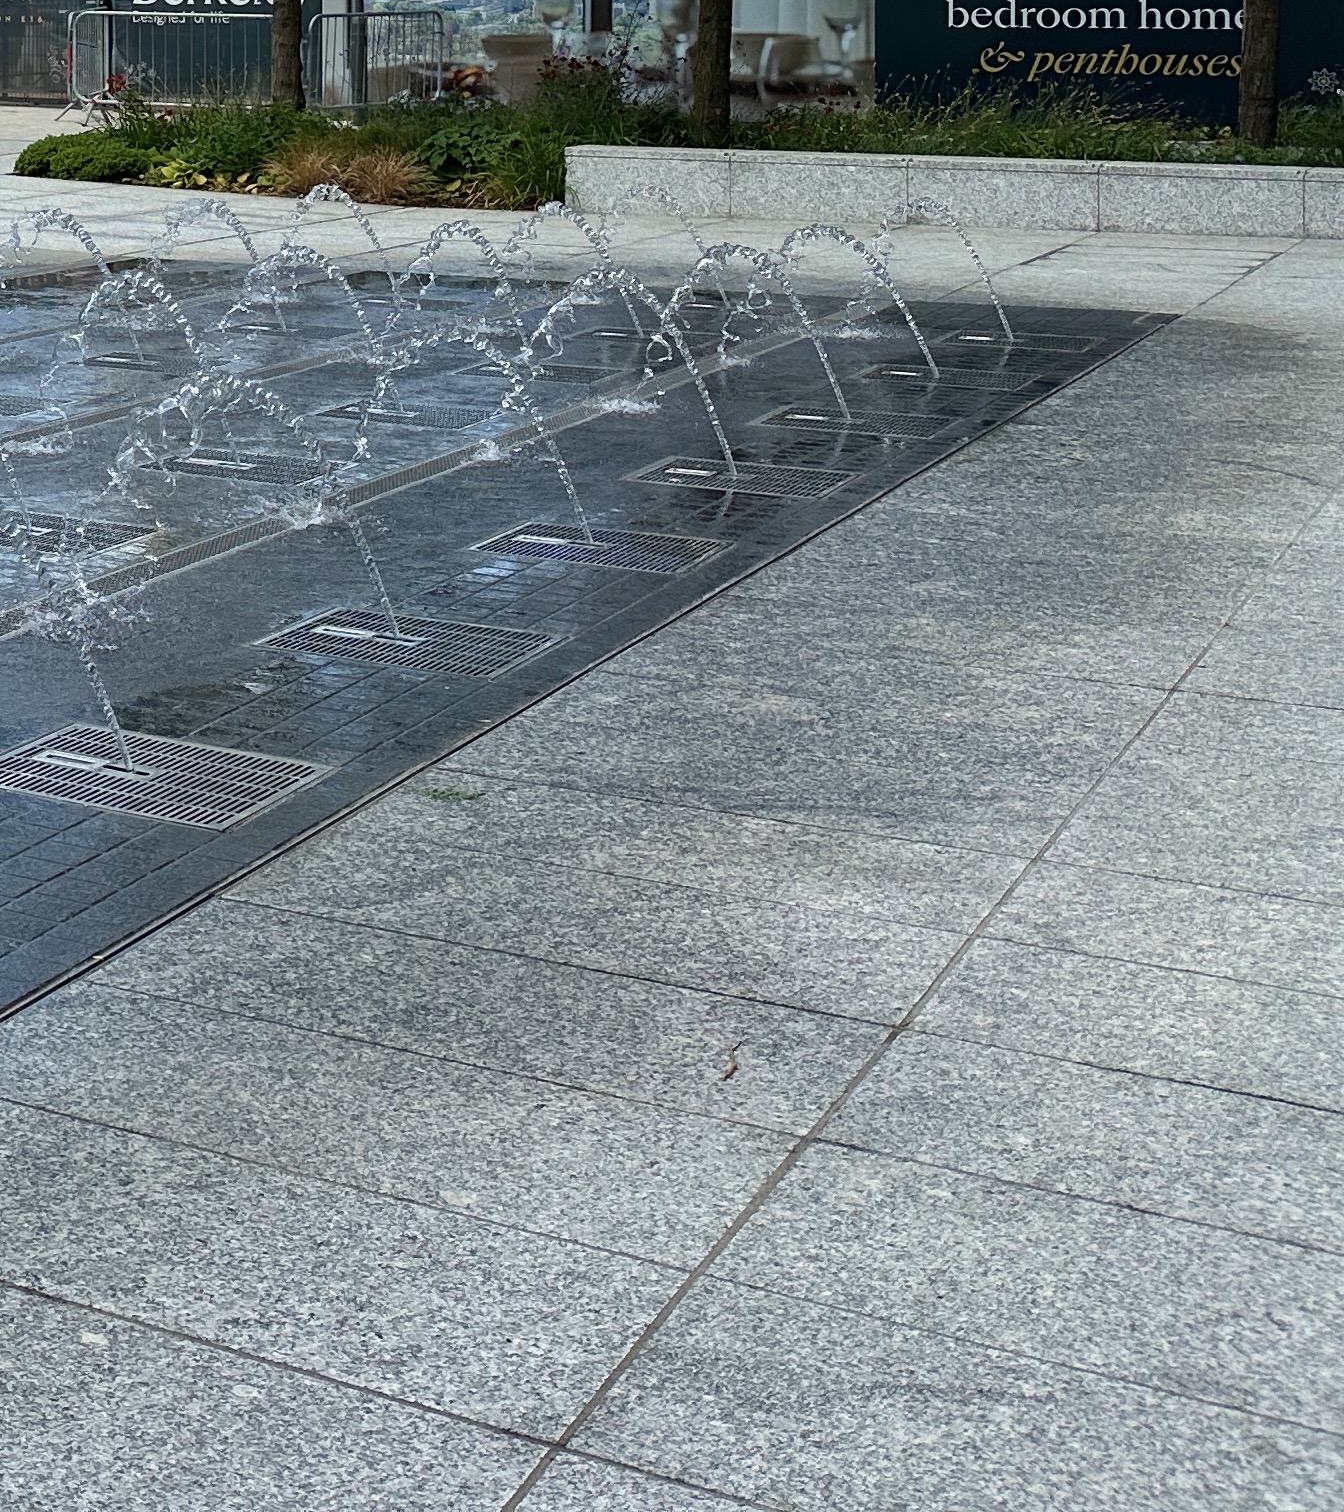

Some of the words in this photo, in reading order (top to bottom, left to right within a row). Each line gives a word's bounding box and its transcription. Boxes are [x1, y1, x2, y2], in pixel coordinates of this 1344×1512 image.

[20, 14, 44, 23] E16
[132, 10, 186, 26] Designed
[980, 40, 1026, 74] &
[1025, 43, 1243, 83] penthouses
